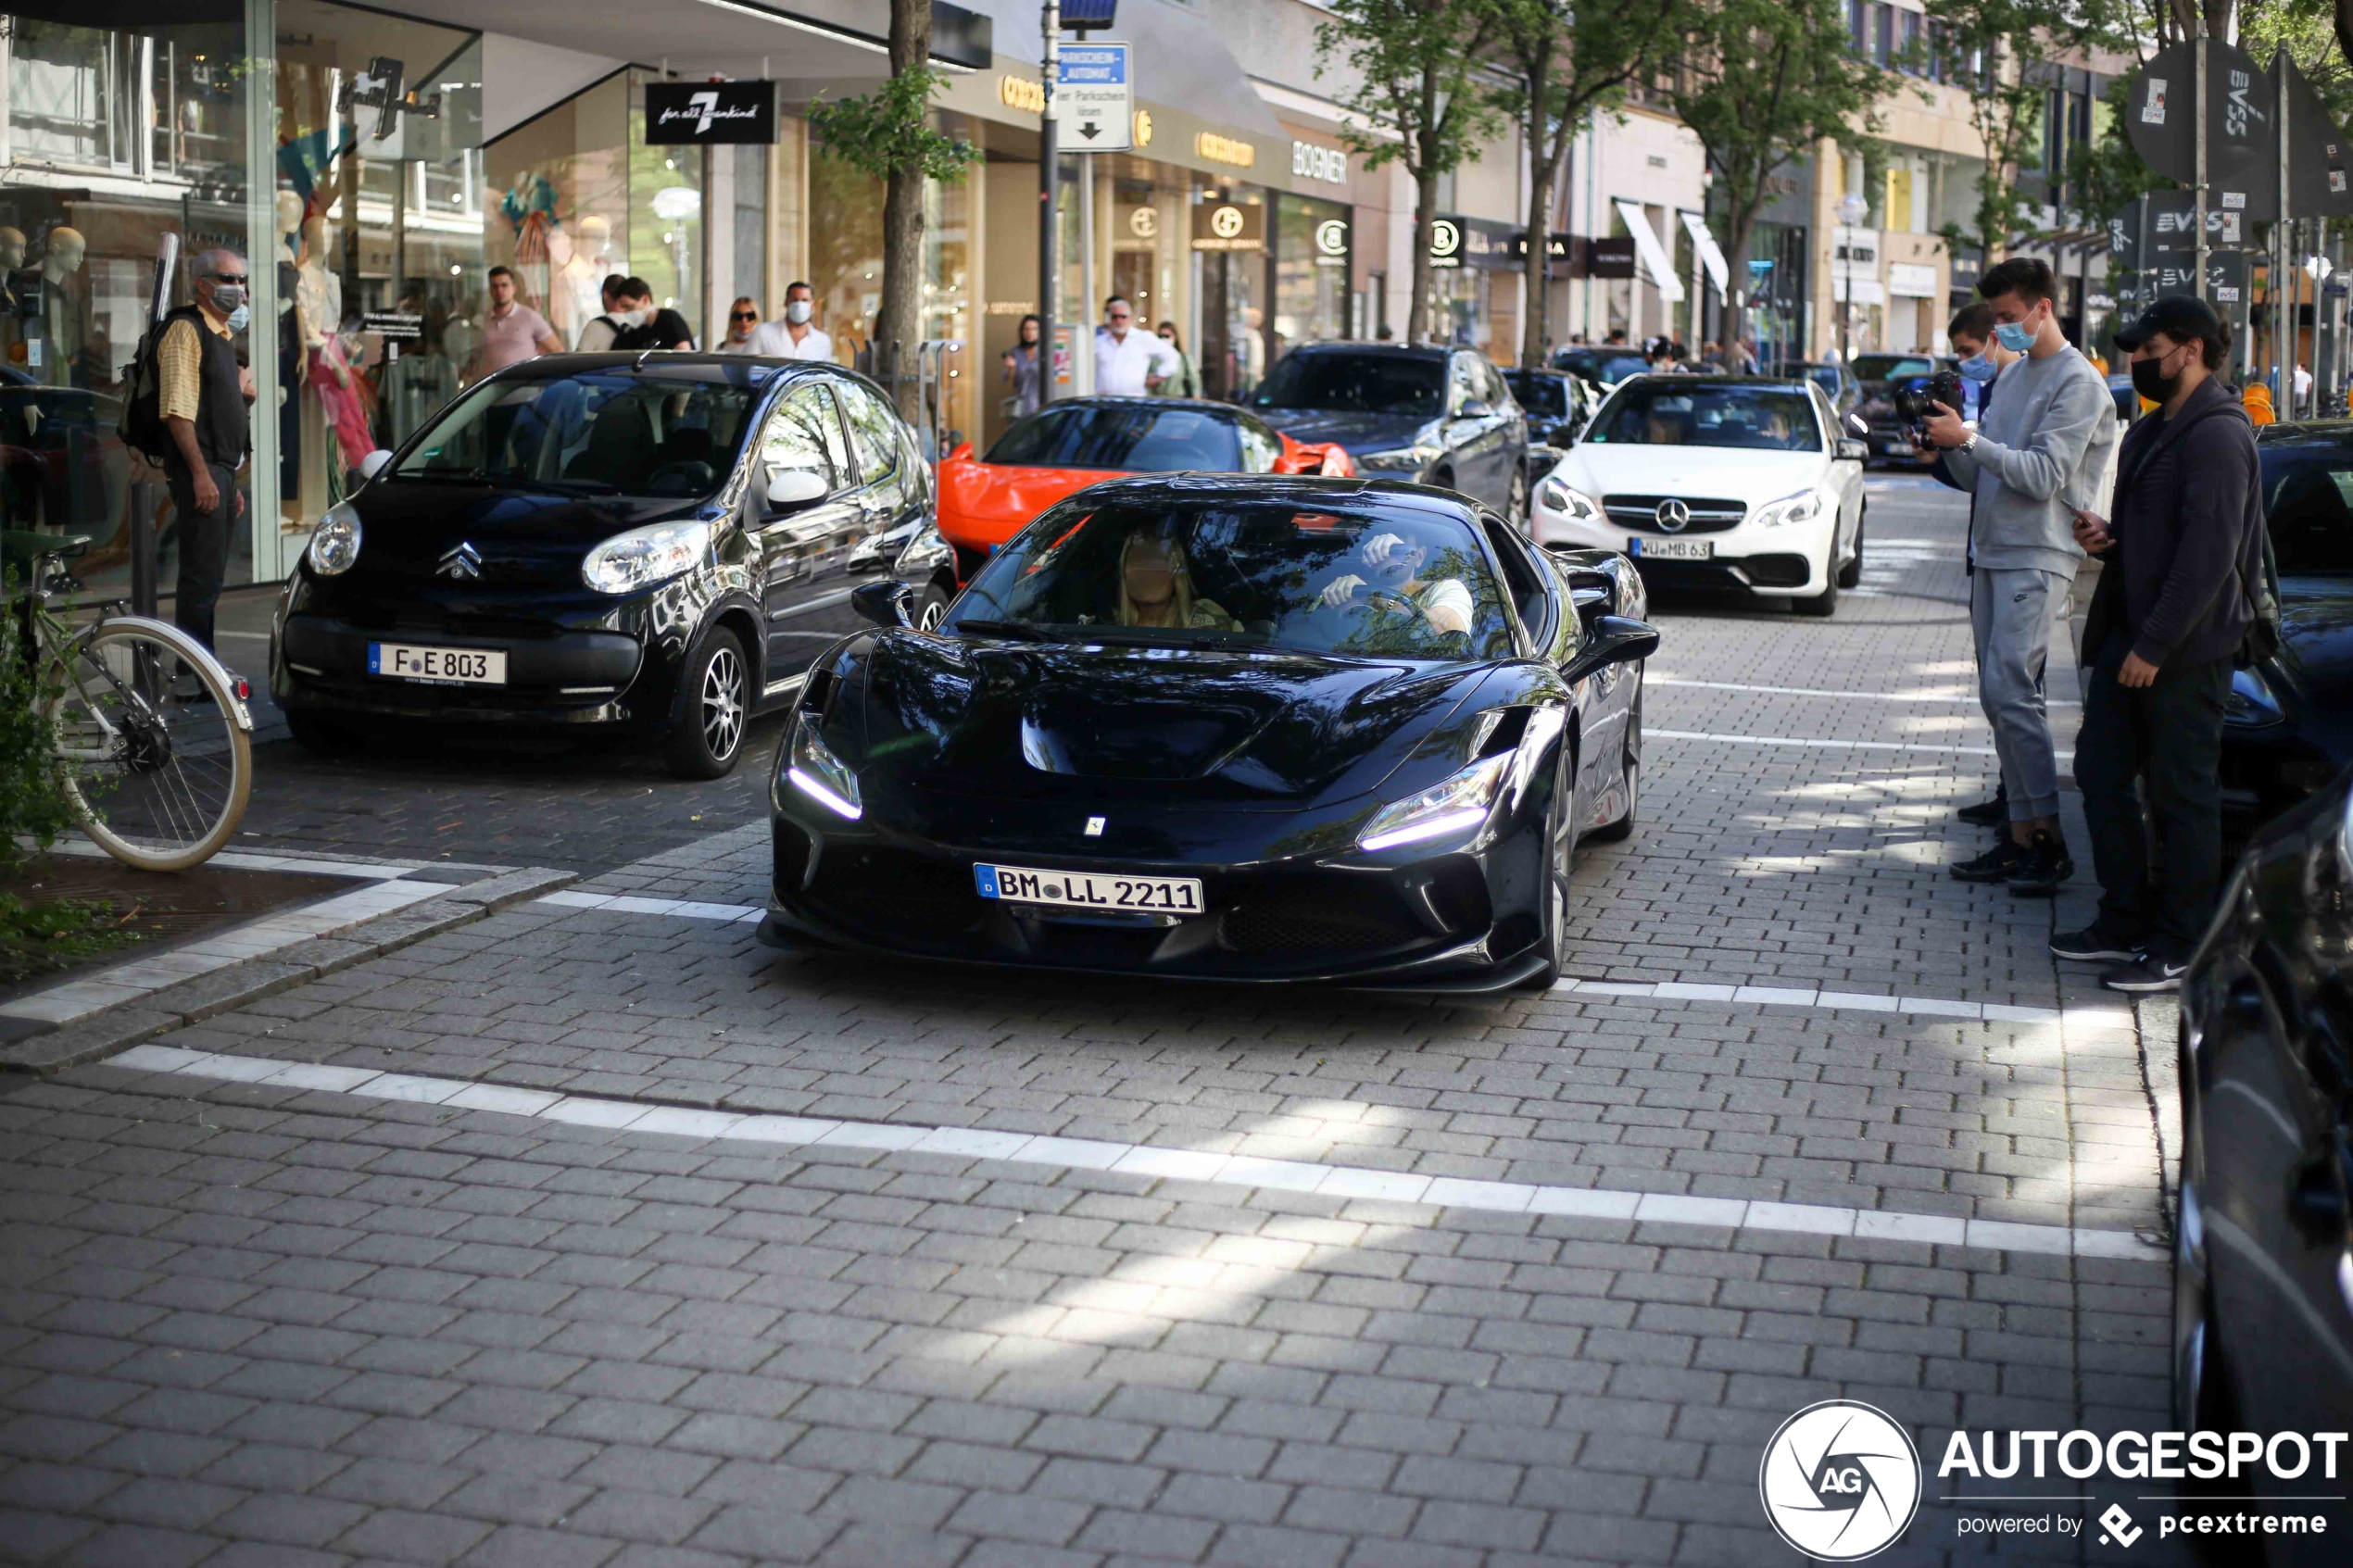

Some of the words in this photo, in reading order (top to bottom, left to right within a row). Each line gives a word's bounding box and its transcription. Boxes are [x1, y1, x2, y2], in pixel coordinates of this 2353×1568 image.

[688, 92, 719, 134] 7
[1292, 140, 1347, 183] BOGNER
[2157, 206, 2223, 232] EVS
[1668, 543, 1686, 556] MB
[1690, 544, 1707, 557] 63
[396, 649, 409, 671] F
[424, 651, 438, 675] E
[444, 653, 486, 678] 803
[985, 884, 993, 892] D
[998, 872, 1041, 898] BM
[1064, 877, 1107, 904] LL
[1114, 882, 1198, 909] 2211
